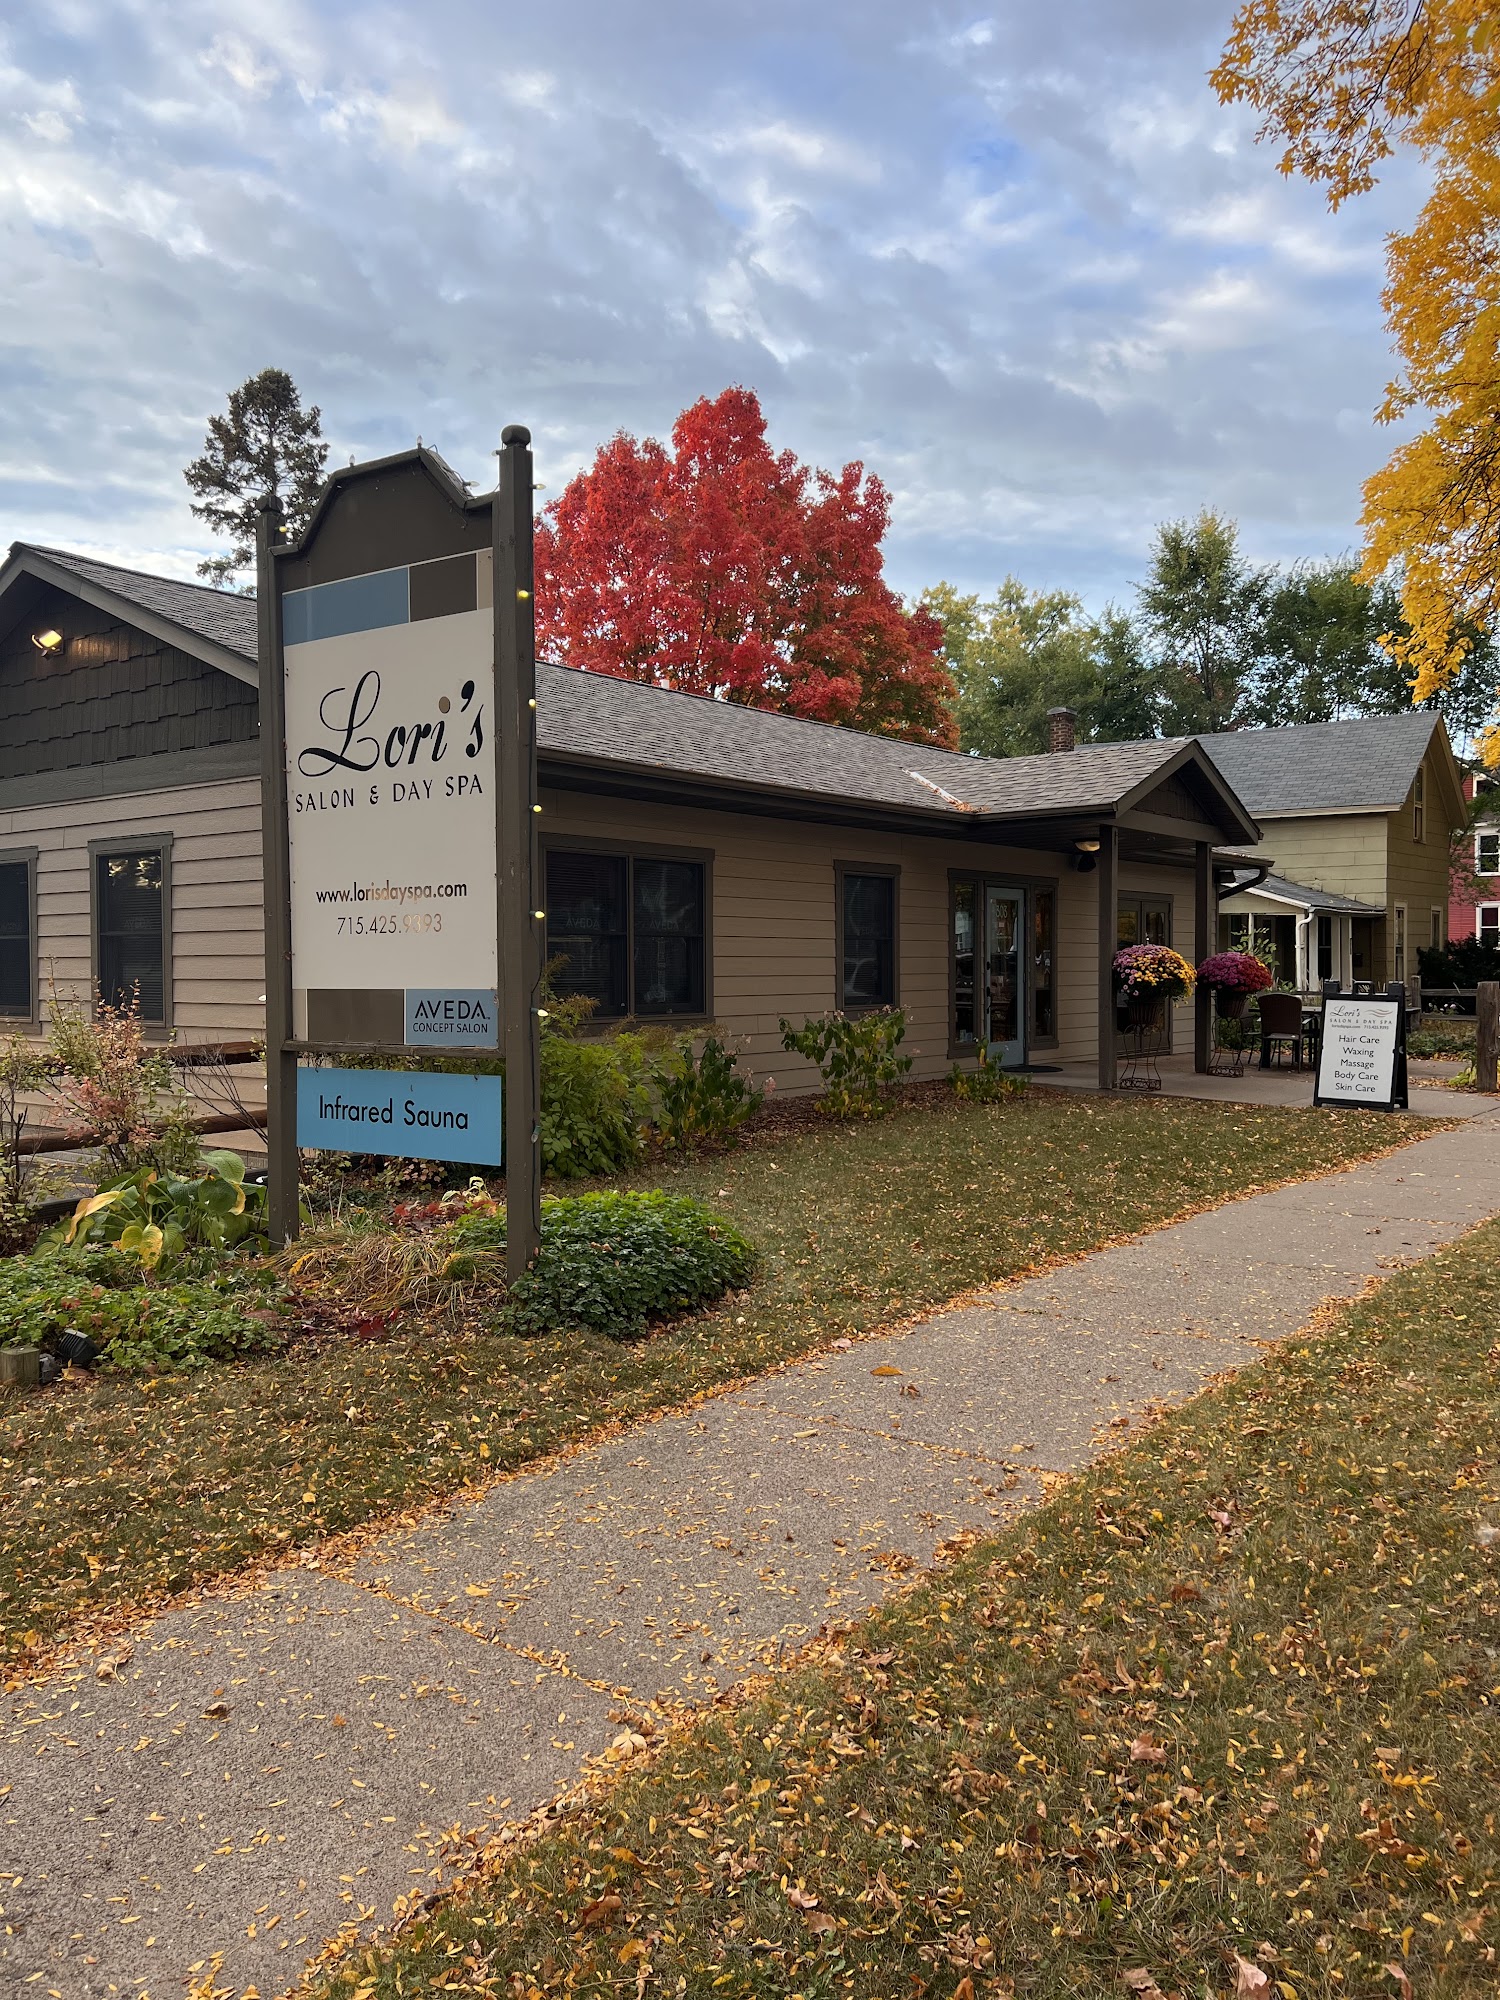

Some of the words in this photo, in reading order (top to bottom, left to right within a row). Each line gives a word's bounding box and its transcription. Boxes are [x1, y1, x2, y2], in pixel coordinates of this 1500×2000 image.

[297, 670, 485, 778] Lori's
[295, 787, 355, 813] SALON
[369, 785, 380, 806] &
[392, 779, 434, 803] DAY
[445, 773, 484, 798] SPA
[315, 879, 468, 906] www.lorisdayspa.com
[337, 913, 442, 935] 715.425.9393
[414, 999, 487, 1020] AVEDA
[1330, 1005, 1361, 1017] Lori's
[412, 1022, 455, 1033] CONCEPT
[456, 1023, 488, 1034] SALON
[1338, 1034, 1357, 1043] Hair
[1359, 1035, 1380, 1044] Care
[1342, 1046, 1375, 1058] Waxing
[1340, 1058, 1375, 1070] Massage
[1334, 1070, 1356, 1081] Body
[1358, 1072, 1379, 1081] Care
[1335, 1082, 1353, 1092] Skin
[1355, 1083, 1376, 1093] Care
[319, 1094, 394, 1125] Infrared
[403, 1099, 469, 1130] Sauna
